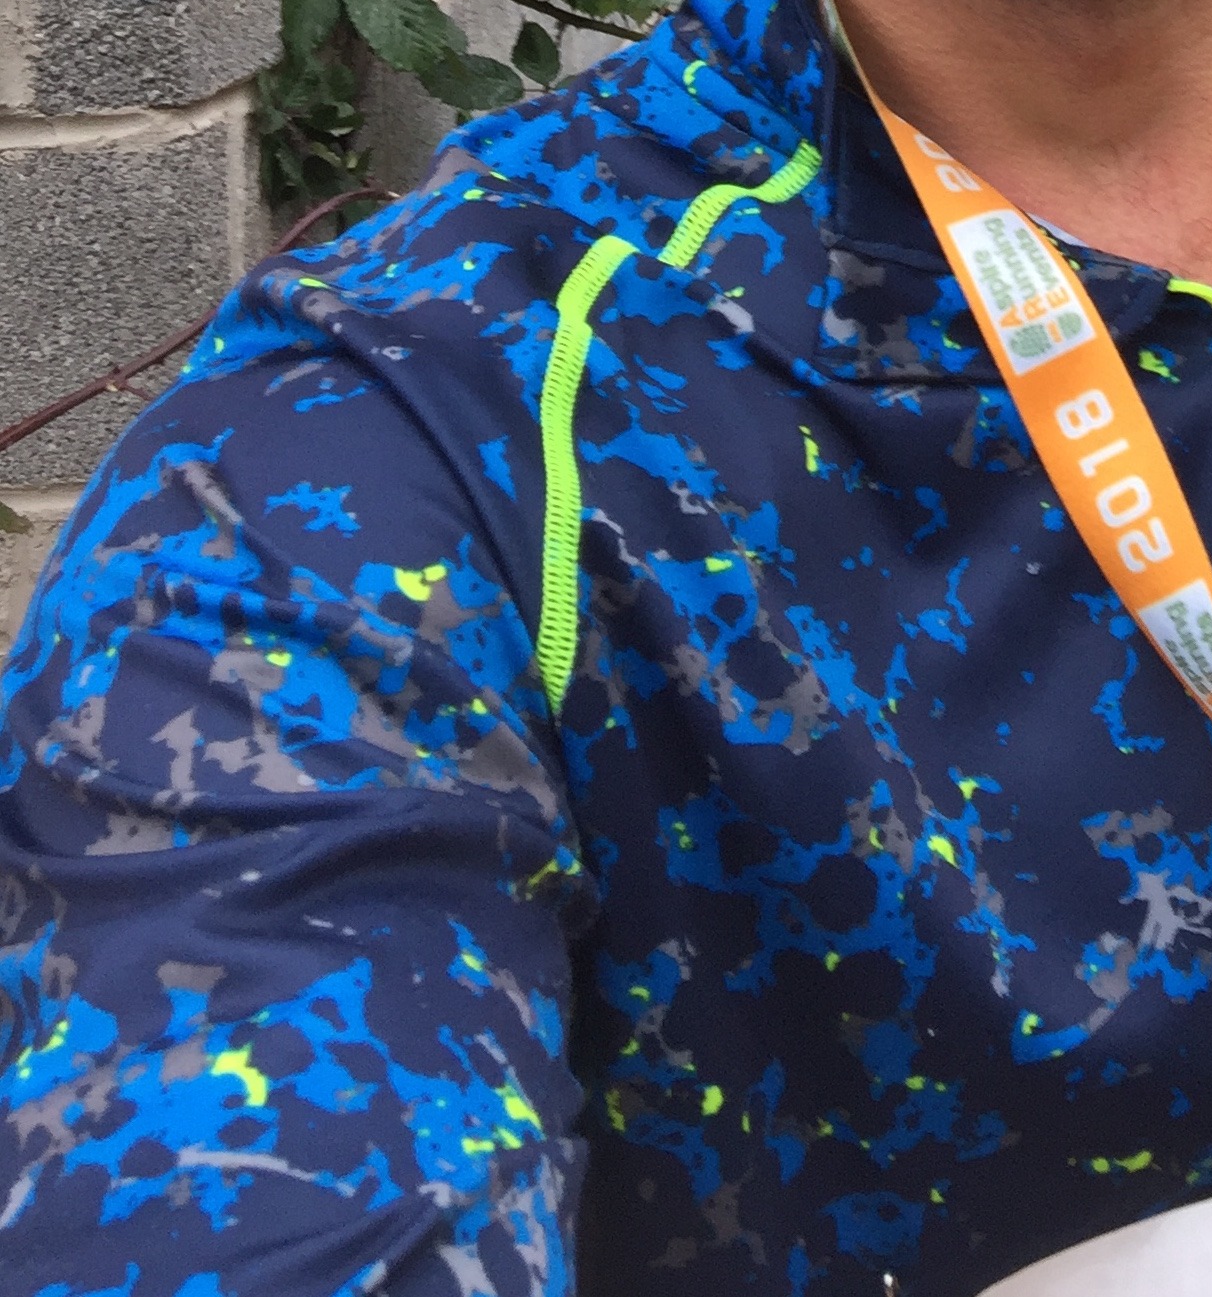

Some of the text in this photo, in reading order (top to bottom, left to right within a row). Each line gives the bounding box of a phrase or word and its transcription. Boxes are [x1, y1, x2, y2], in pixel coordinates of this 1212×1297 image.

[974, 249, 1023, 328] Aspire
[984, 218, 1047, 320] Running
[1014, 227, 1071, 309] Events
[1055, 388, 1175, 574] 2018
